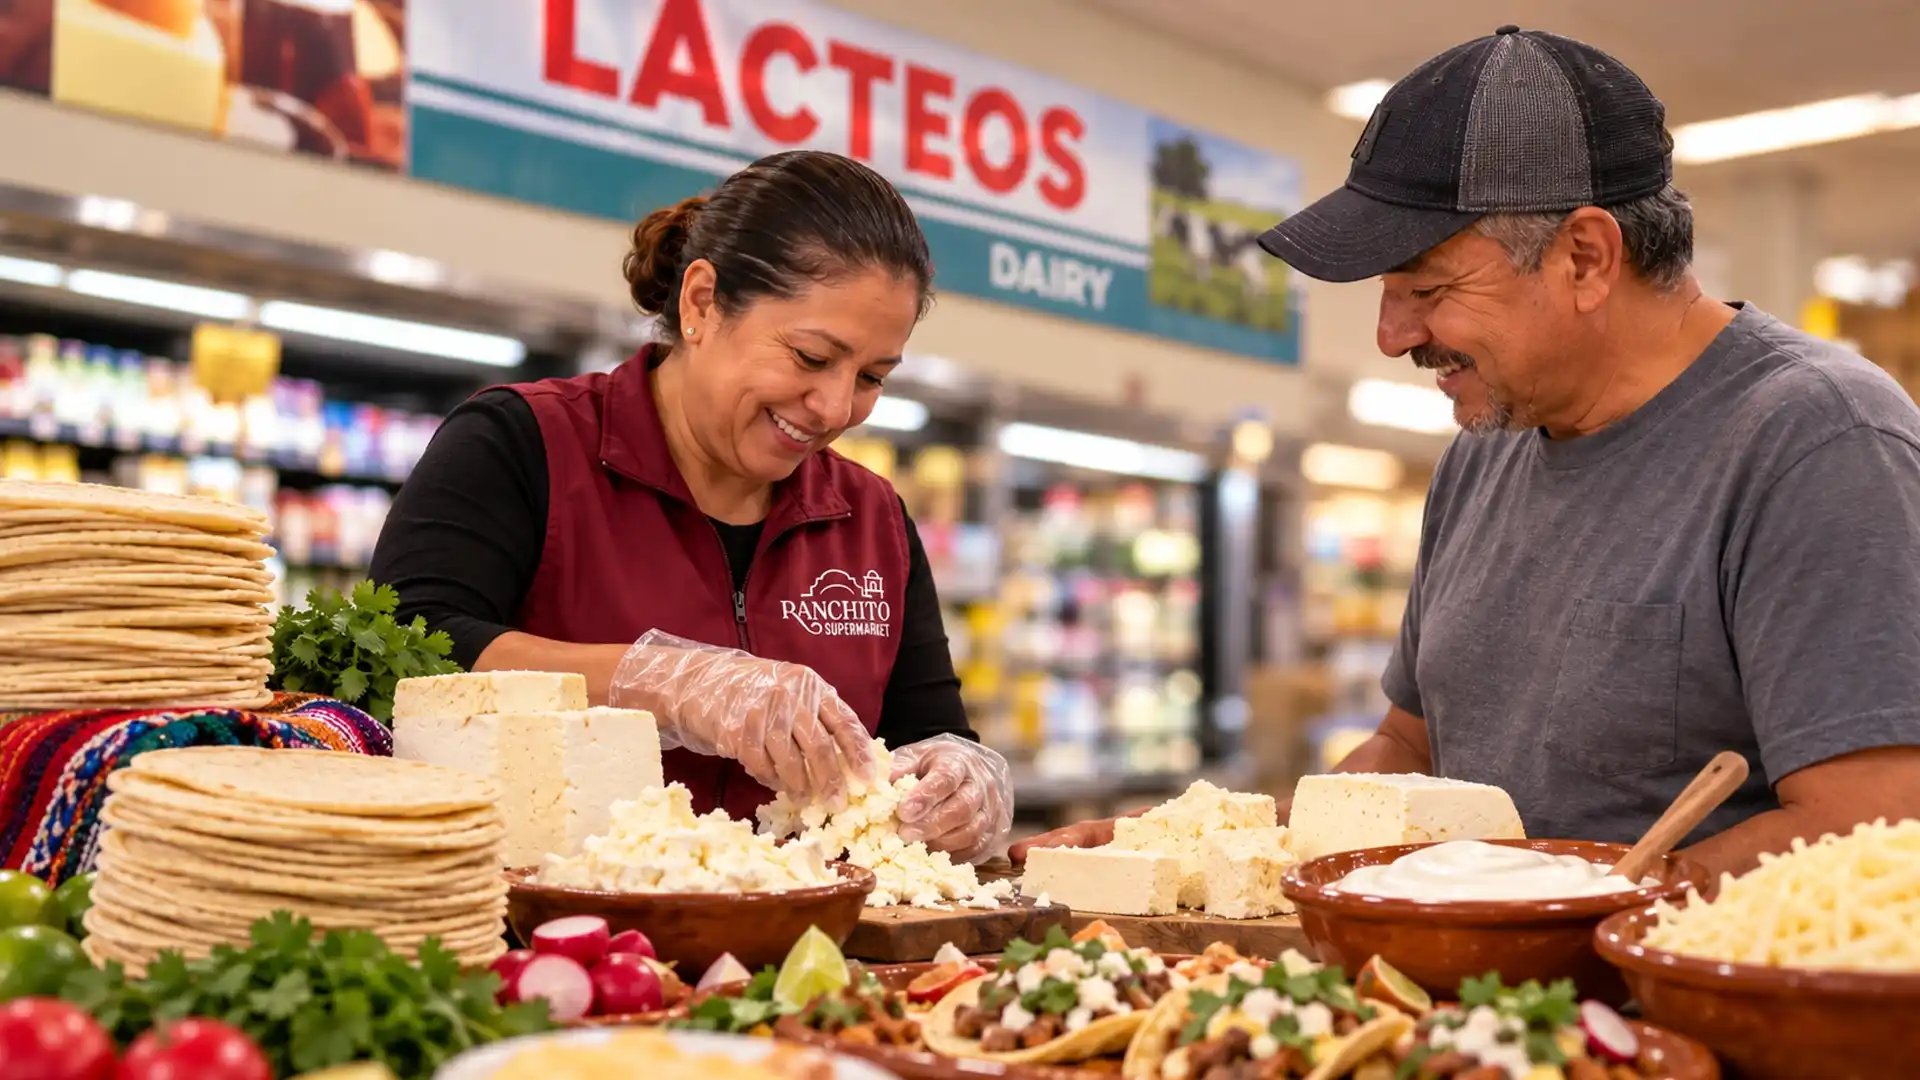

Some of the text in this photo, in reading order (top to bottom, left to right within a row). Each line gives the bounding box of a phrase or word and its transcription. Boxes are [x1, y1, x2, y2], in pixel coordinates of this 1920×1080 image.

[543, 0, 1086, 210] LACTEOS
[990, 242, 1113, 310] DAIRY
[780, 600, 890, 634] RANCHITO
